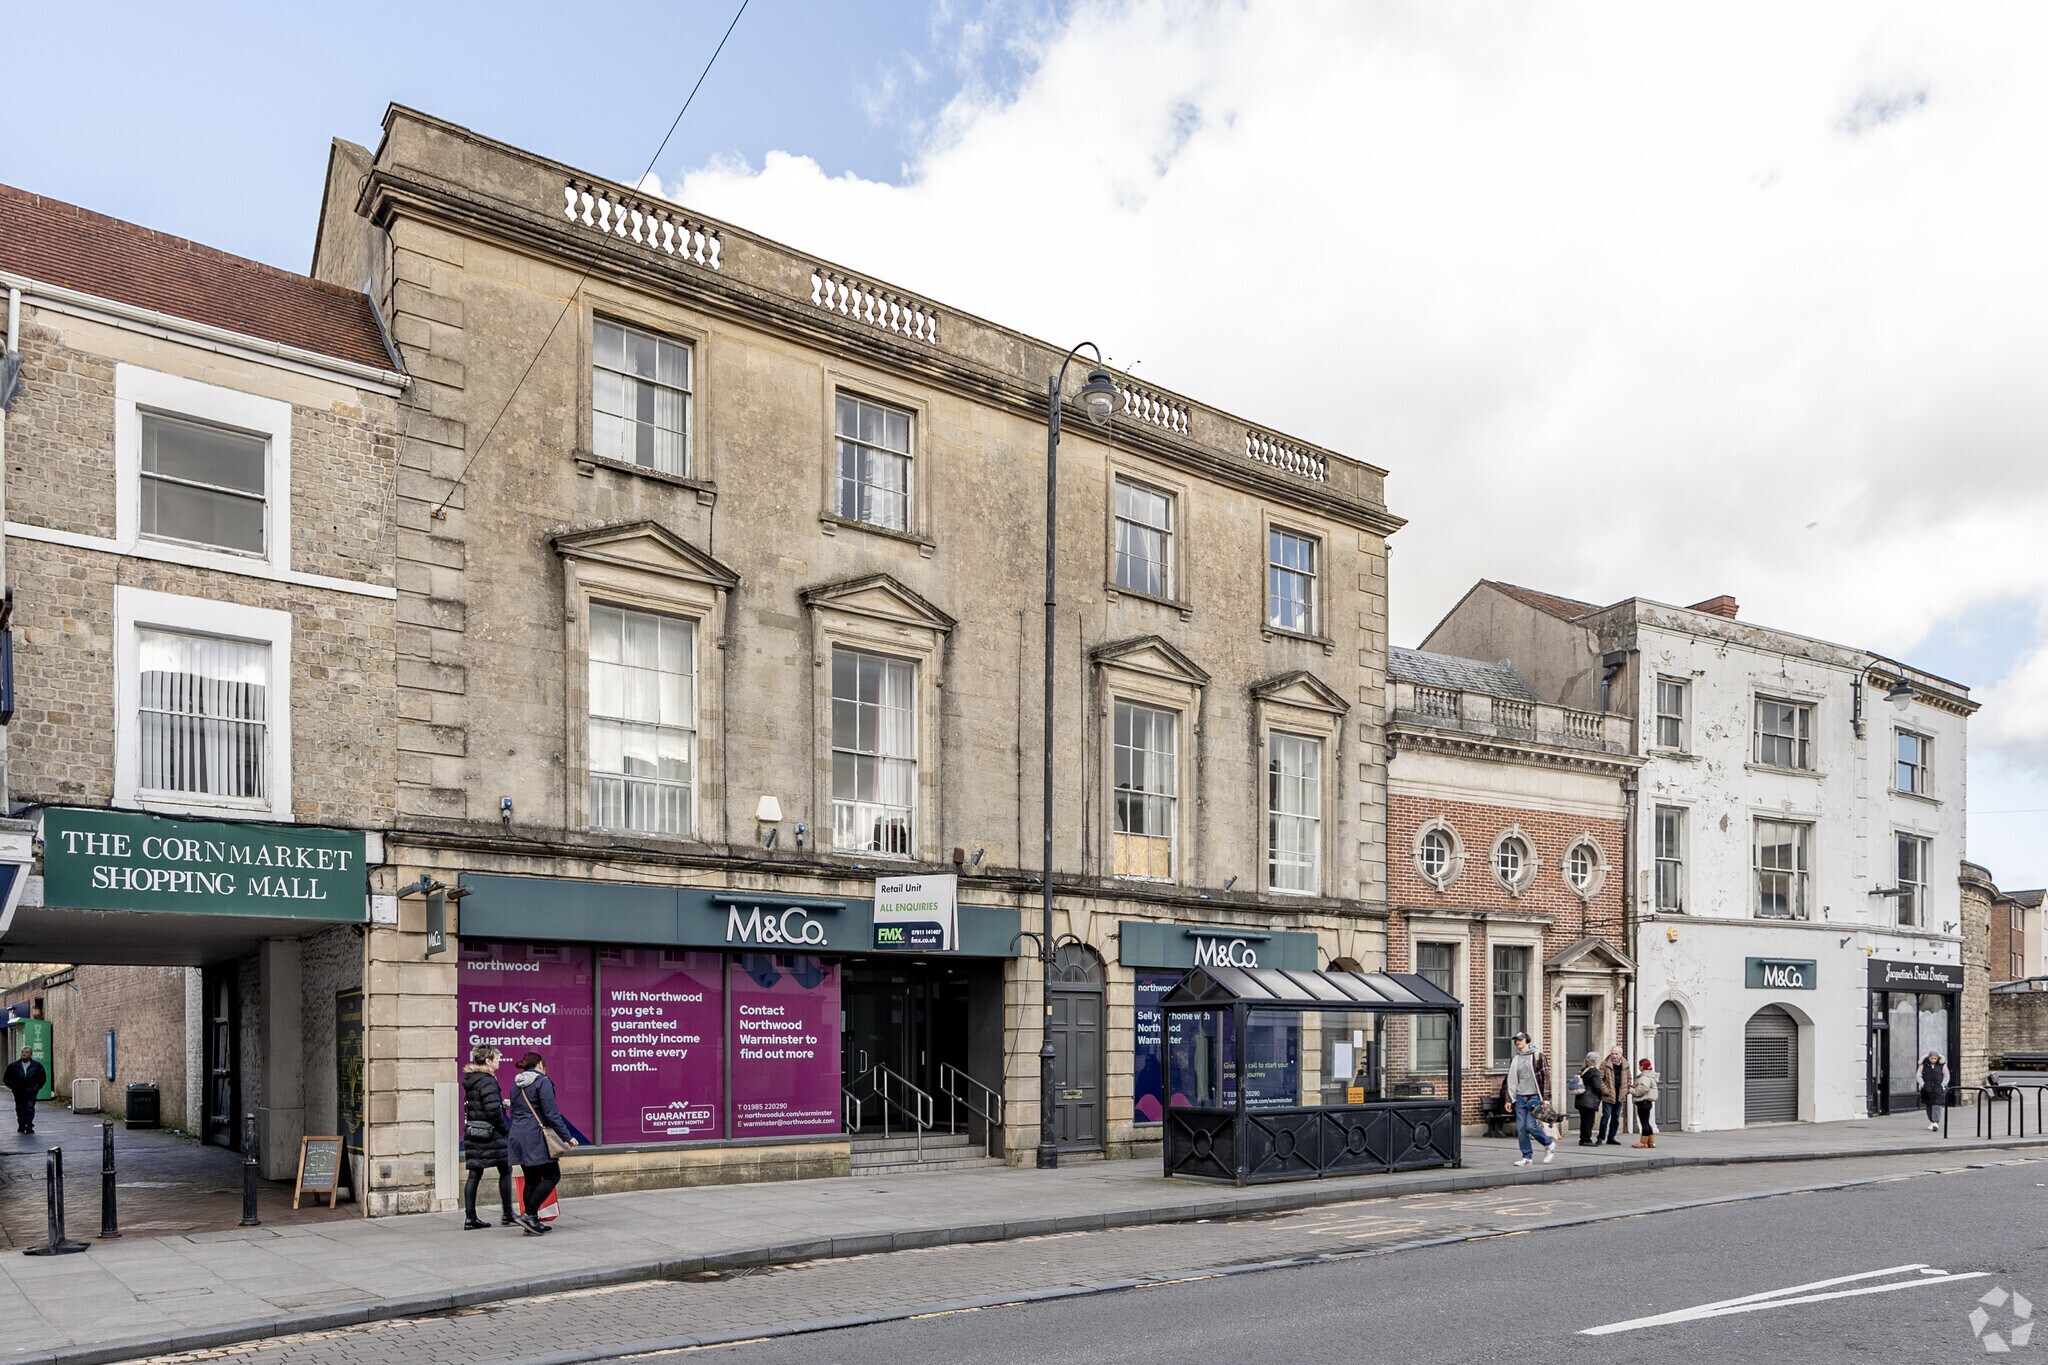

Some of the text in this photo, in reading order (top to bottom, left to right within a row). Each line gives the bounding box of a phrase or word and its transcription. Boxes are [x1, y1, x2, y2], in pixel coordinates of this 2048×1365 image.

[61, 830, 353, 872] THE CORNMARKET
[91, 865, 328, 900] SHOPPING MALL
[881, 883, 922, 893] Retail Unit
[880, 902, 938, 912] ALL ENQUIRIES
[726, 904, 828, 946] M&Co.
[911, 936, 937, 944] fmx.co.uk
[1194, 936, 1259, 969] M&Co.
[467, 960, 540, 972] northwood
[1763, 964, 1804, 987] M&Co.
[1914, 965, 1929, 980] Bridal
[1929, 966, 1949, 984] Boutique
[1138, 984, 1177, 992] northwoo
[611, 990, 703, 1002] With Northwood
[469, 1001, 496, 1013] The
[532, 1002, 556, 1014] No1
[611, 1007, 633, 1018] you
[634, 1006, 655, 1018] get
[739, 1004, 785, 1016] Contact
[1137, 1011, 1153, 1020] Sell
[1171, 1012, 1194, 1020] home
[469, 1018, 547, 1032] provider of
[611, 1019, 677, 1032] guaranteed
[739, 1019, 803, 1030] Northwood
[469, 1034, 552, 1046] Guaranteed
[611, 1033, 700, 1046] monthly income
[739, 1034, 818, 1045] Warminster to
[611, 1047, 688, 1060] on time every
[740, 1048, 814, 1059] find out more
[611, 1061, 658, 1072] month...
[743, 1103, 764, 1111] 01985
[764, 1102, 788, 1110] 220290
[645, 1110, 710, 1121] GUARANTEED
[744, 1110, 833, 1119] northwooduk.com/warminster
[737, 1117, 835, 1128] E warminster@northwooduk.com
